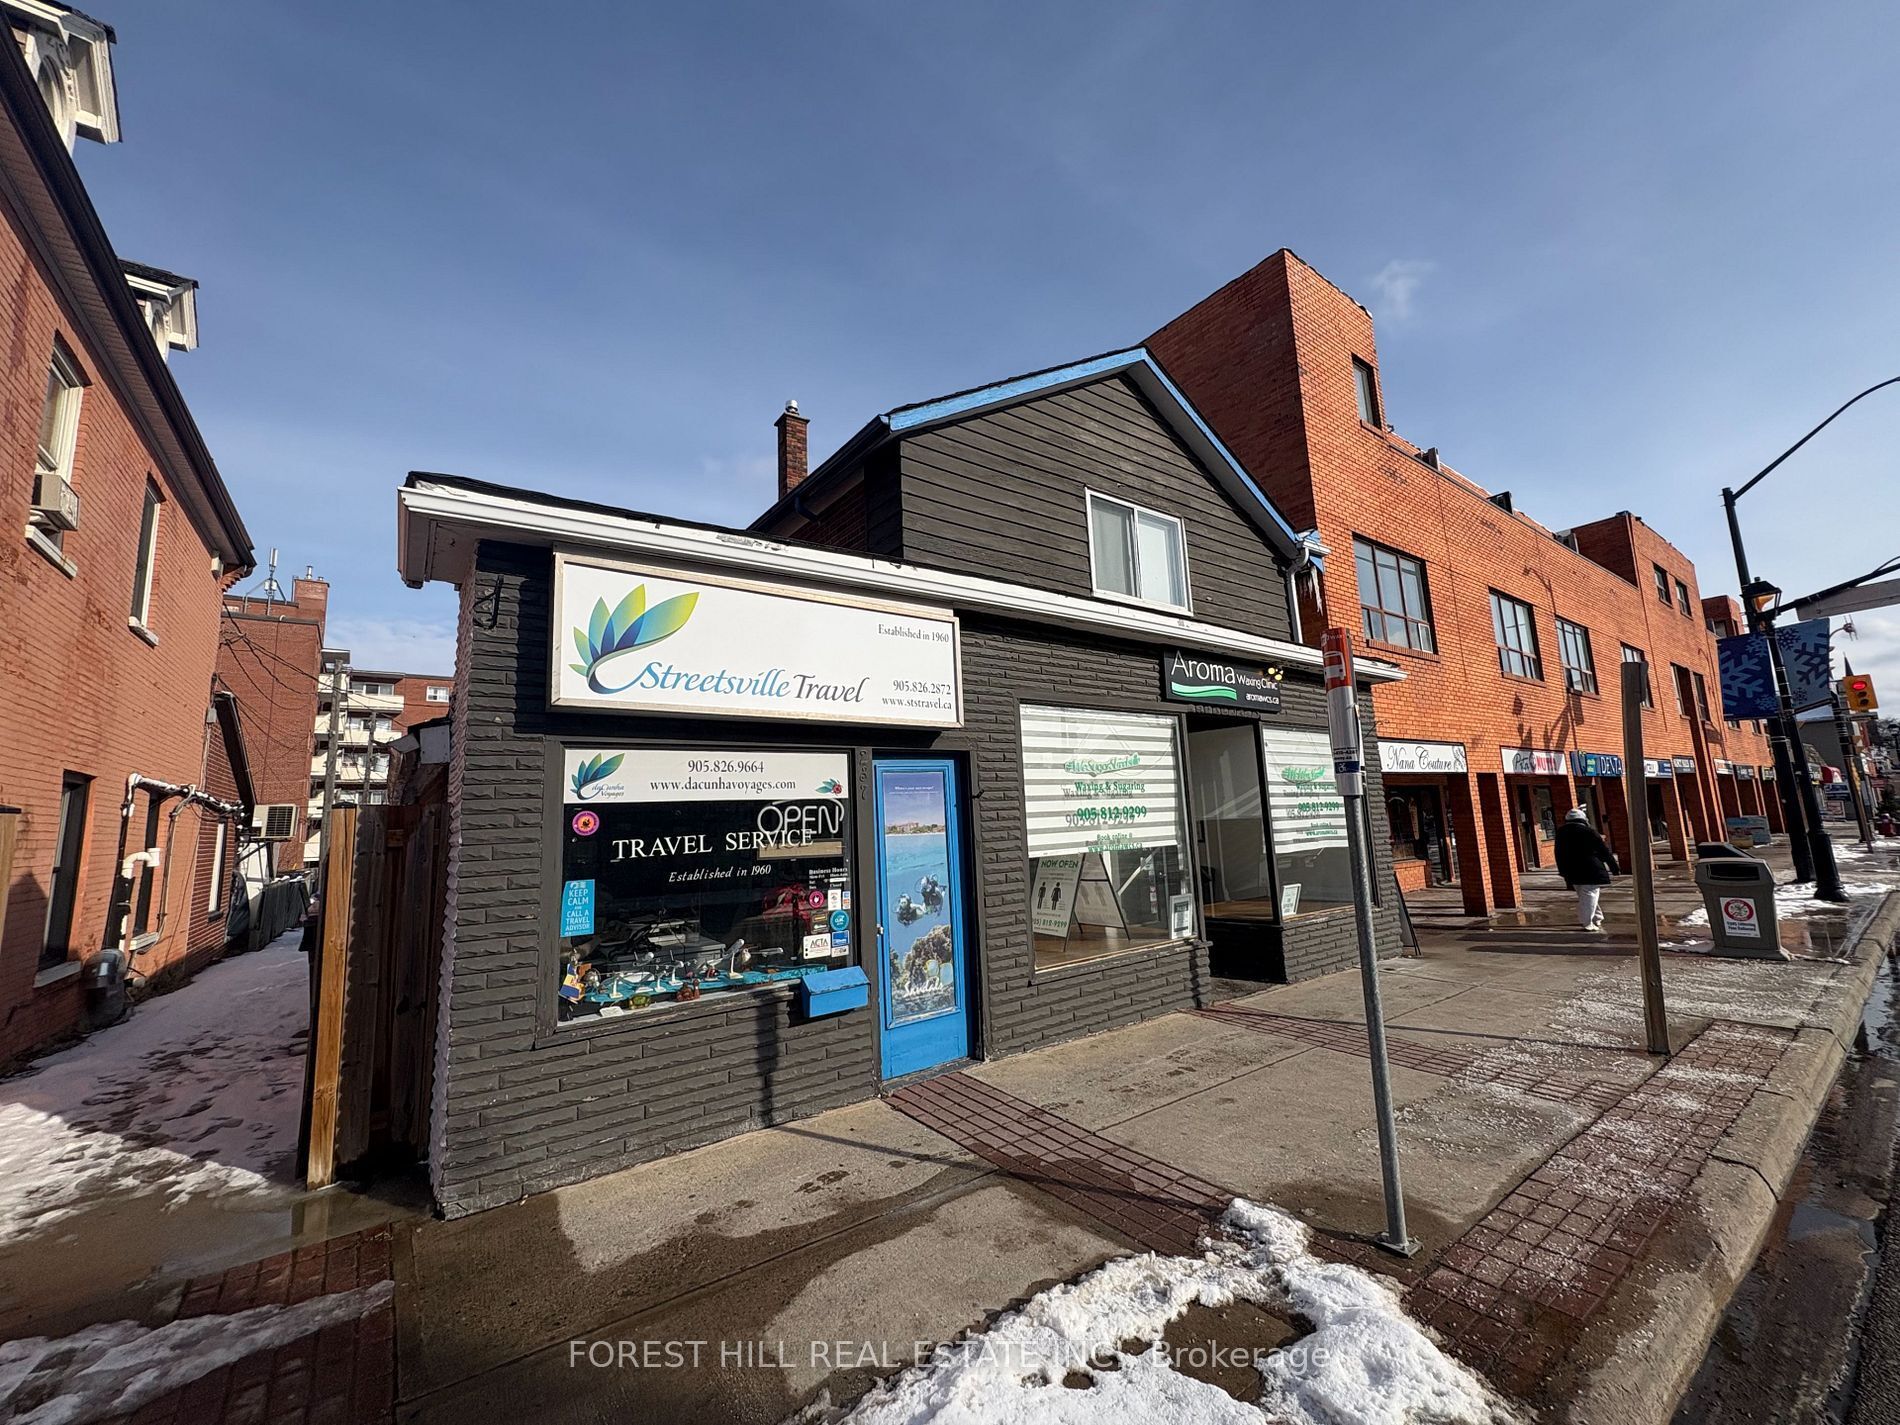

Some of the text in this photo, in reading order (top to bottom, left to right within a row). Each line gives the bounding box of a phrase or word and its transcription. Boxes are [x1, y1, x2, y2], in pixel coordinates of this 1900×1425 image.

[878, 623, 950, 643] Established in 1960
[1171, 650, 1278, 691] Aroma Waxing Clinic
[638, 660, 870, 703] Streetsville Travel
[893, 679, 952, 696] 905.826.2872
[881, 697, 952, 711] www.ststravel.ca
[1386, 745, 1452, 770] Nana Couture
[687, 759, 765, 773] 905.826.9664
[650, 776, 797, 795] www.dacunhavoyages.com
[1075, 781, 1146, 794] Waxing & Sugaring
[757, 805, 839, 835] OPEN
[1077, 805, 1147, 821] 905-812-9299
[612, 828, 814, 860] TRAVEL SERVICE
[1040, 860, 1078, 868] NOW OPEN
[668, 864, 772, 883] Established in 1960
[568, 889, 589, 897] KEEP
[567, 897, 589, 906] CALM
[566, 910, 583, 918] CALL
[566, 916, 590, 925] TRAVEL
[565, 923, 591, 931] ADVISOR
[810, 938, 829, 949] ACTA
